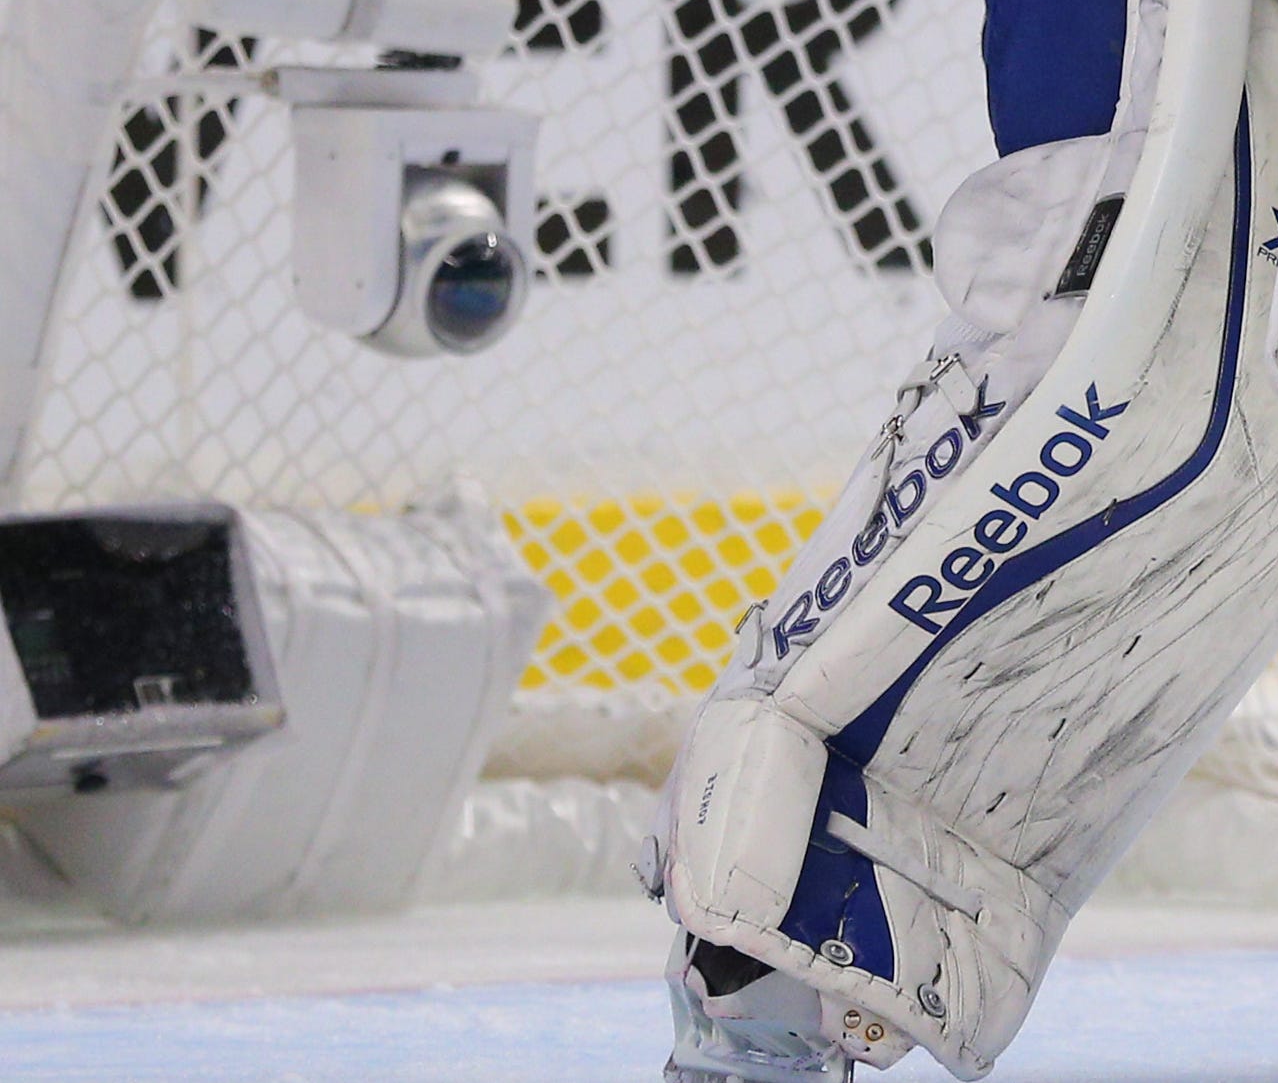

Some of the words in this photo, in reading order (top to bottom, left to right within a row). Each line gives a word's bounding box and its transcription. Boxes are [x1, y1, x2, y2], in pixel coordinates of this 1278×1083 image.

[1075, 211, 1110, 278] Reebok
[772, 373, 1007, 660] Reebok
[887, 380, 1133, 636] Reebok
